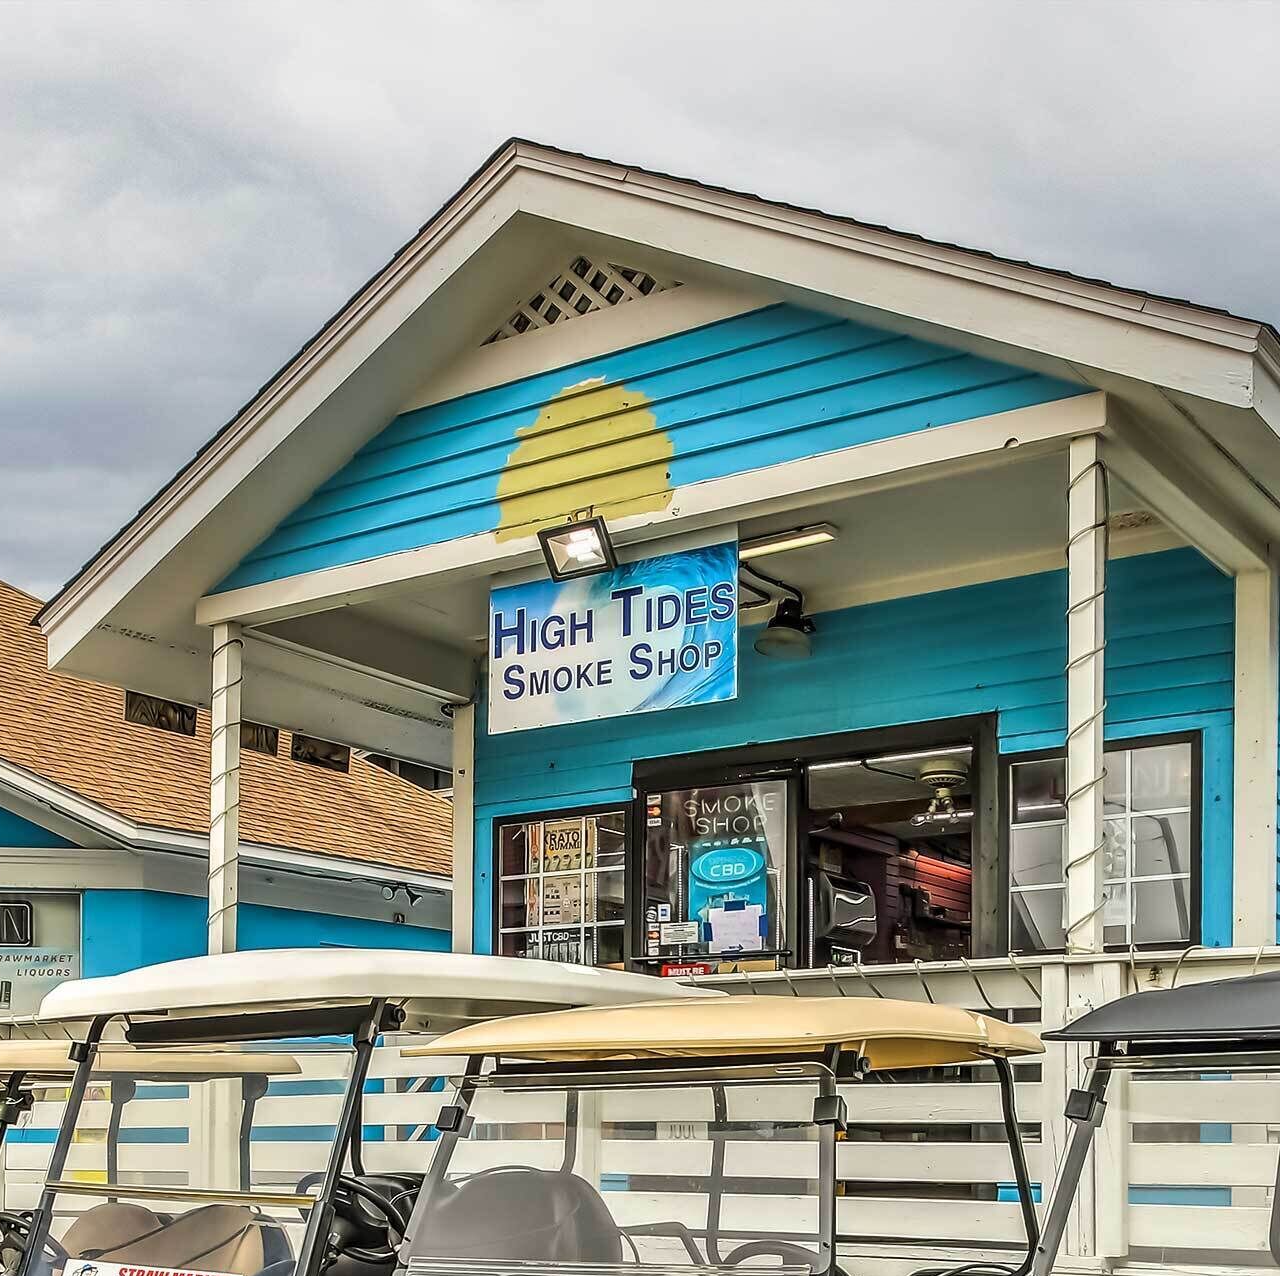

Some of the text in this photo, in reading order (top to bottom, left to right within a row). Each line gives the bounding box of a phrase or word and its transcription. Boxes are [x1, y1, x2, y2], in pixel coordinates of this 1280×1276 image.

[494, 584, 734, 659] HIGH TIDES
[503, 641, 721, 700] SMOKE SHOP
[684, 793, 777, 817] SMOKE
[696, 815, 767, 835] SHOP
[710, 863, 745, 877] CBD
[16, 968, 71, 977] LIQUORS
